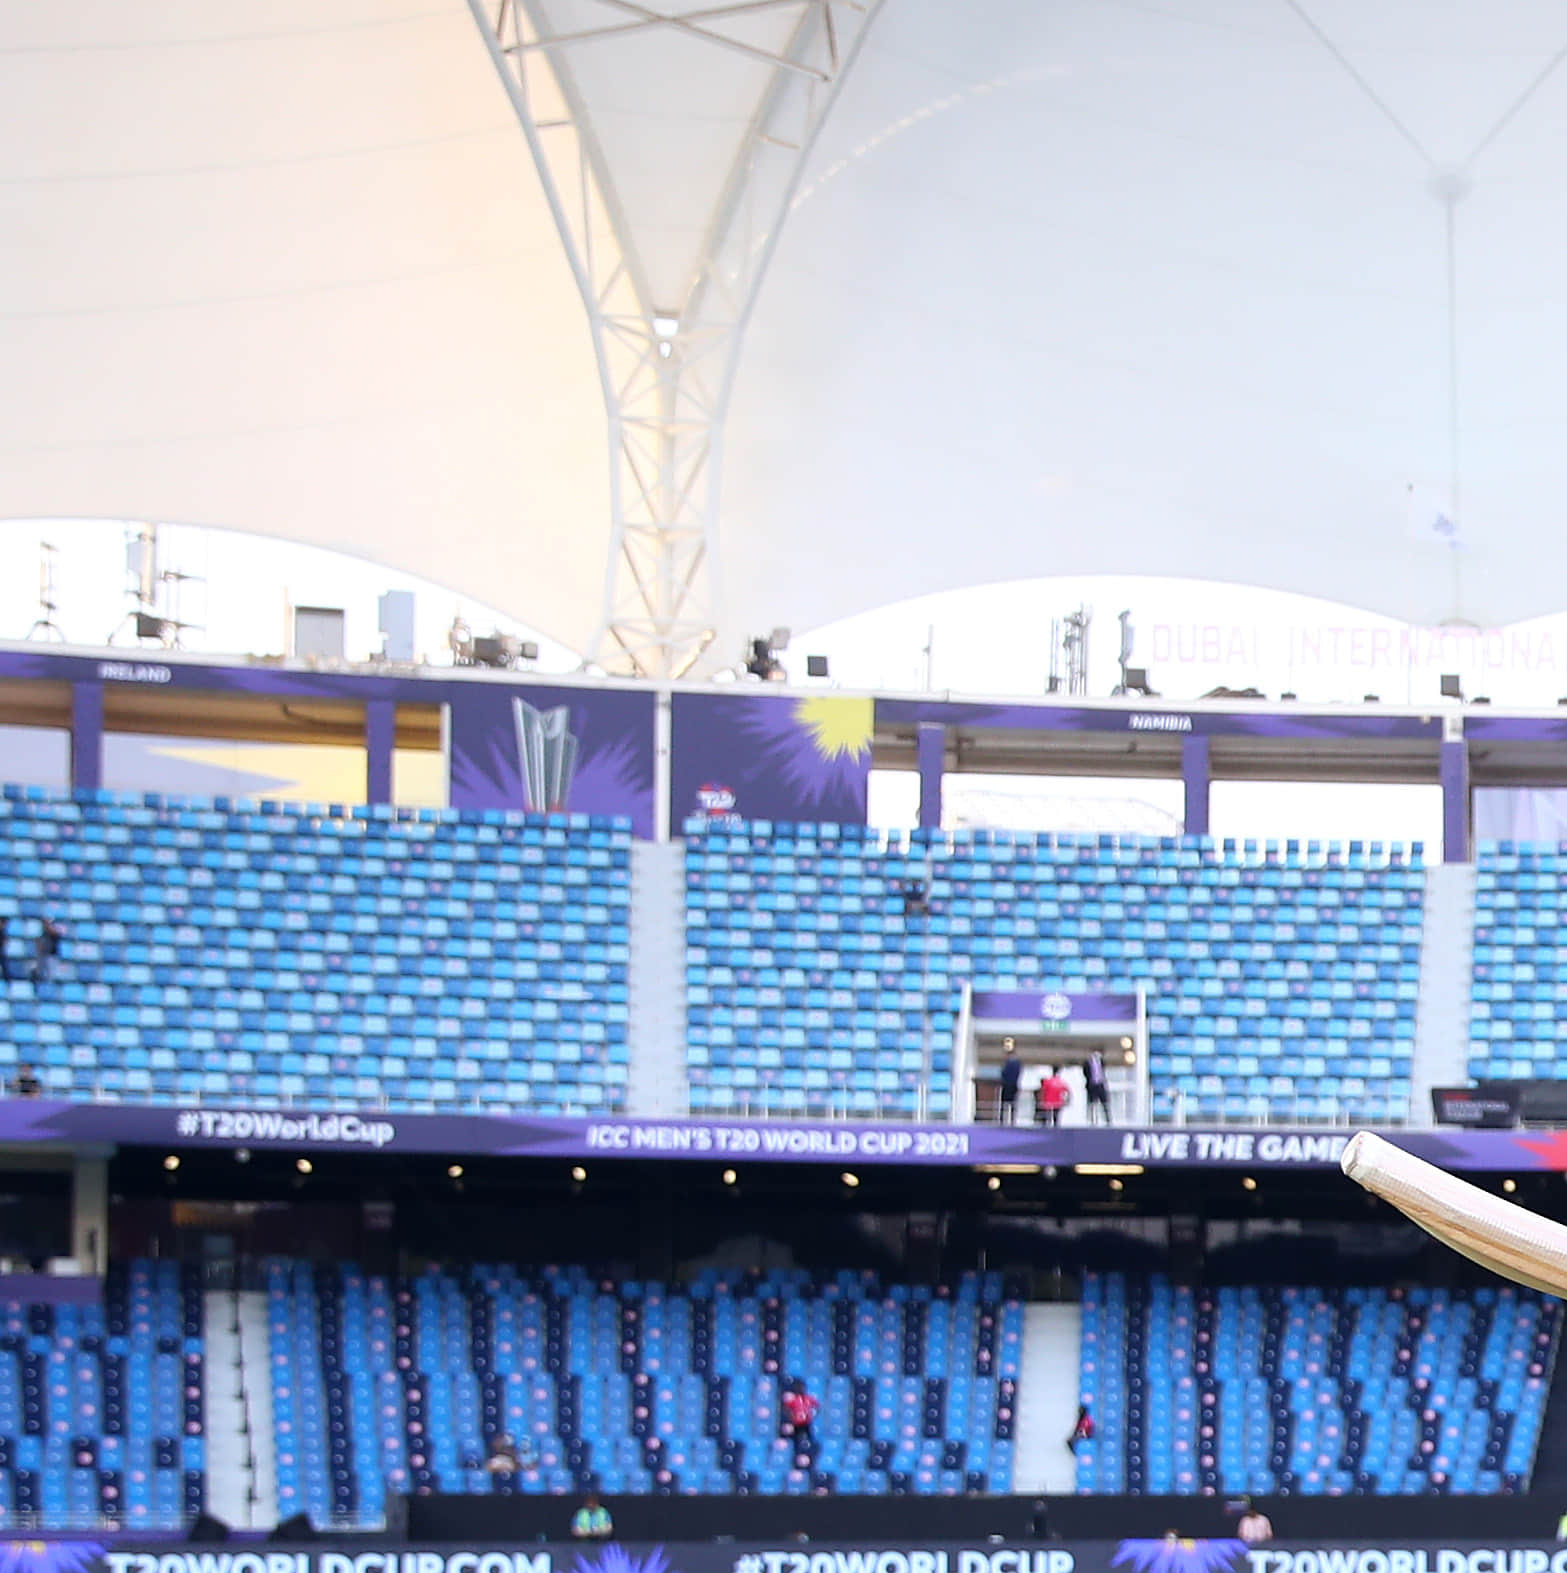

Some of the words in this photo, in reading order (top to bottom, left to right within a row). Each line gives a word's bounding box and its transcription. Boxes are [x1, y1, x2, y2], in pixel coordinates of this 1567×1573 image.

[1152, 624, 1260, 664] DUBAI
[98, 662, 172, 684] IRELAND
[1131, 714, 1192, 732] NAMIBIA
[177, 1111, 395, 1147] #T20WorldCup
[587, 1124, 630, 1148] ICC
[633, 1126, 712, 1150] MEN'S
[715, 1127, 760, 1152] T20
[763, 1129, 857, 1154] WORLD
[860, 1130, 913, 1155] CUP
[916, 1132, 968, 1156] 2021
[1122, 1133, 1190, 1160] LIVE
[1194, 1133, 1255, 1160] THE
[1258, 1134, 1348, 1162] GAME
